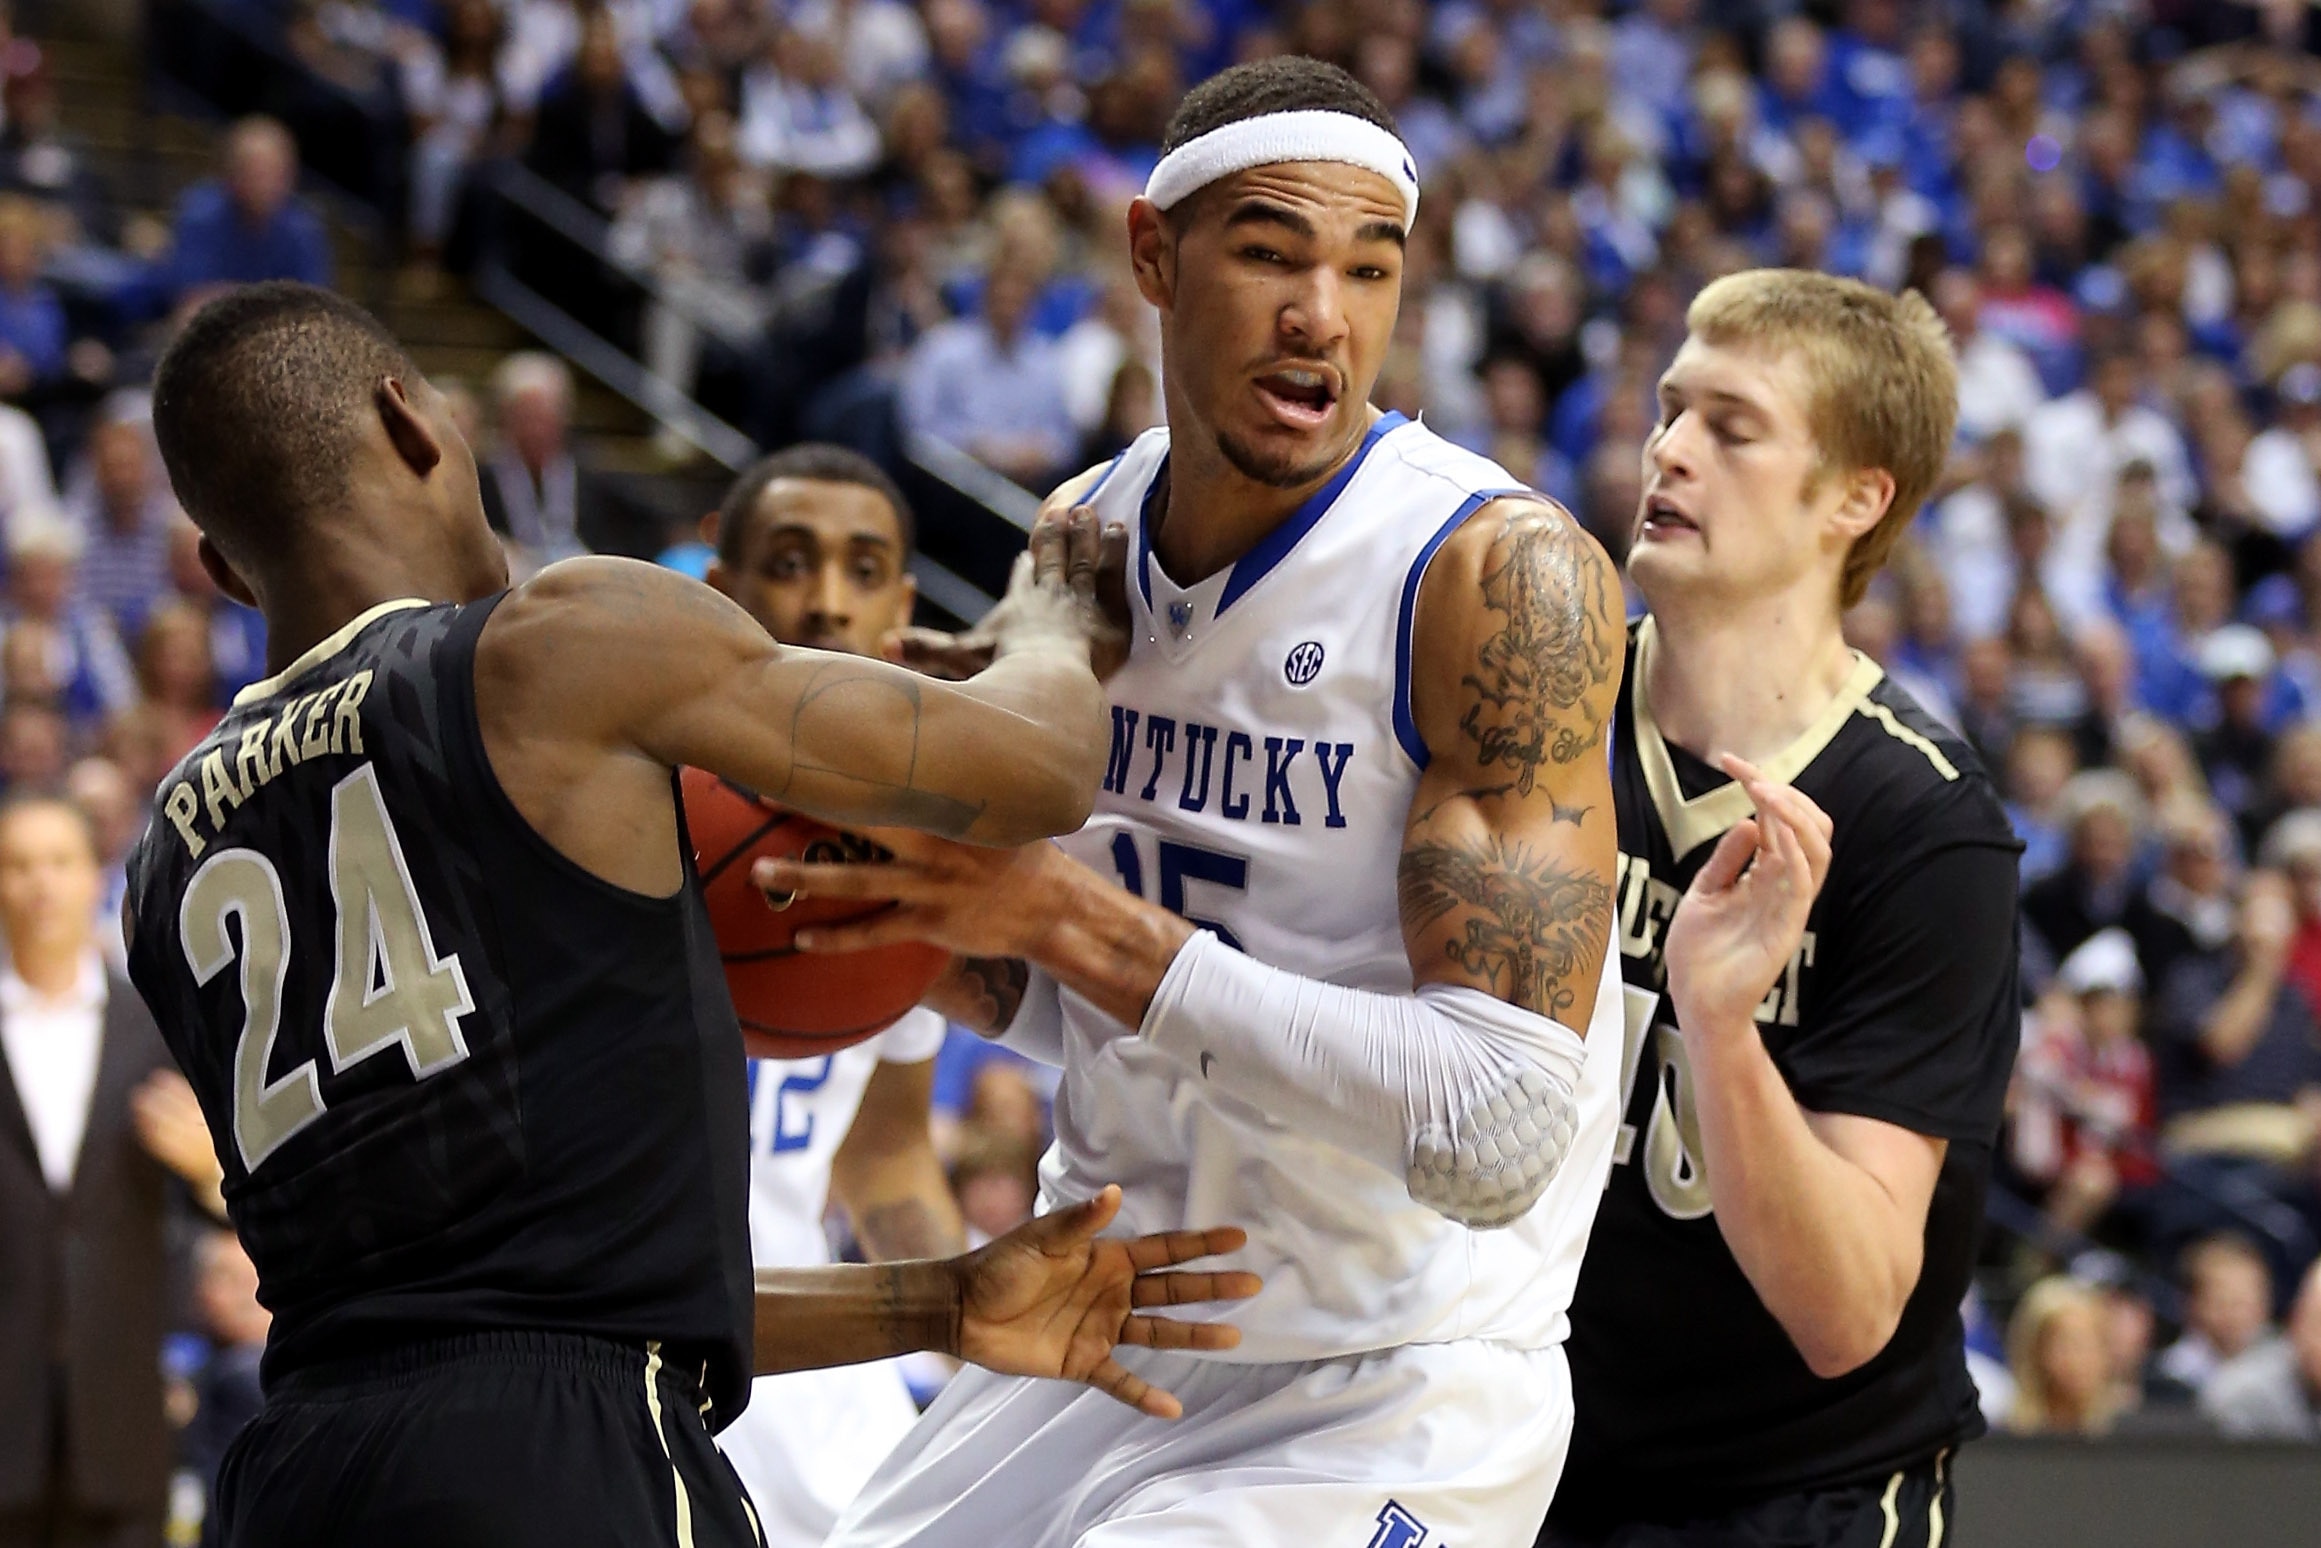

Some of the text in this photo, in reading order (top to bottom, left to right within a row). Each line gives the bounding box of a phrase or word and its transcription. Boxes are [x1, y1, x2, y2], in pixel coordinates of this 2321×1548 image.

[1285, 641, 1325, 685] SEC
[163, 668, 374, 860] PARKER
[1102, 704, 1354, 829] NTUCKY
[180, 761, 476, 1174] 24
